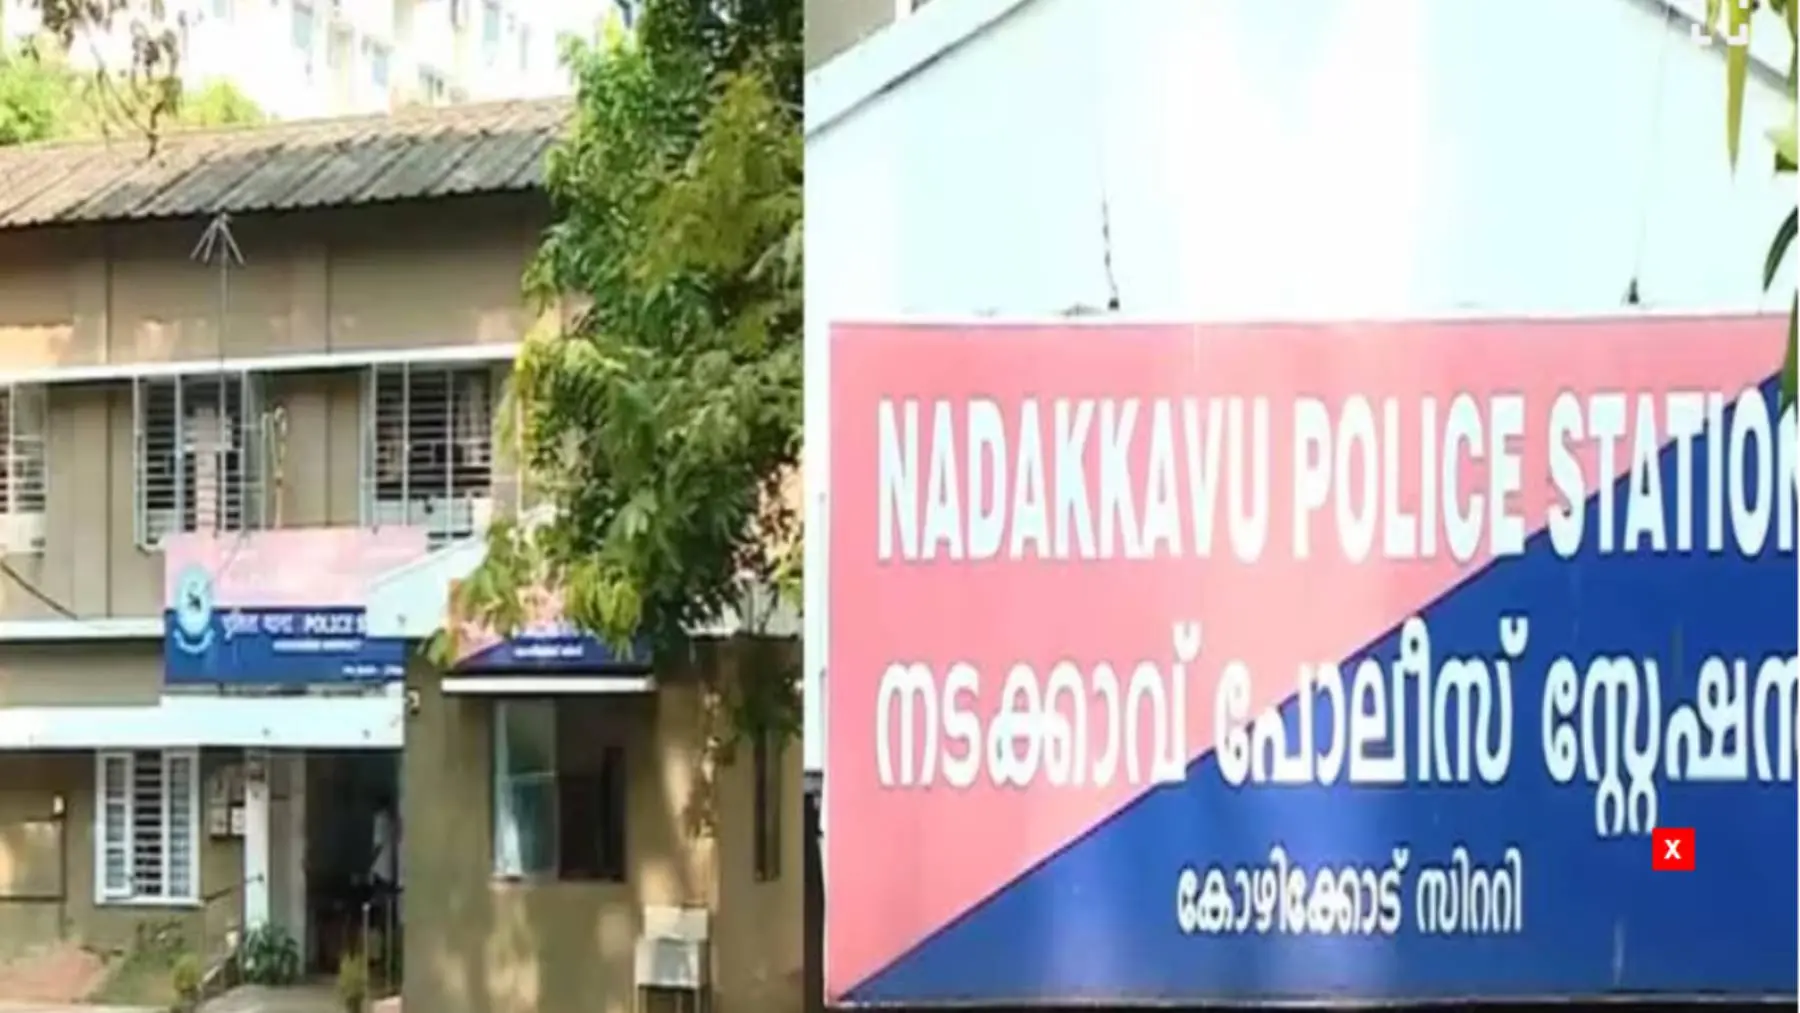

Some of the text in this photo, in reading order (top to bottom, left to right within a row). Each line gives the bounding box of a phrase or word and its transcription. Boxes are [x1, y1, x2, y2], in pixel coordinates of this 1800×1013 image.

[877, 396, 1271, 561] NADAKKAVU
[1294, 392, 1525, 561] POLICE
[876, 620, 1201, 787] നടക്കാവ്
[1214, 615, 1529, 786] പോലീസ്
[1176, 845, 1410, 934] കോഴിക്കോട്
